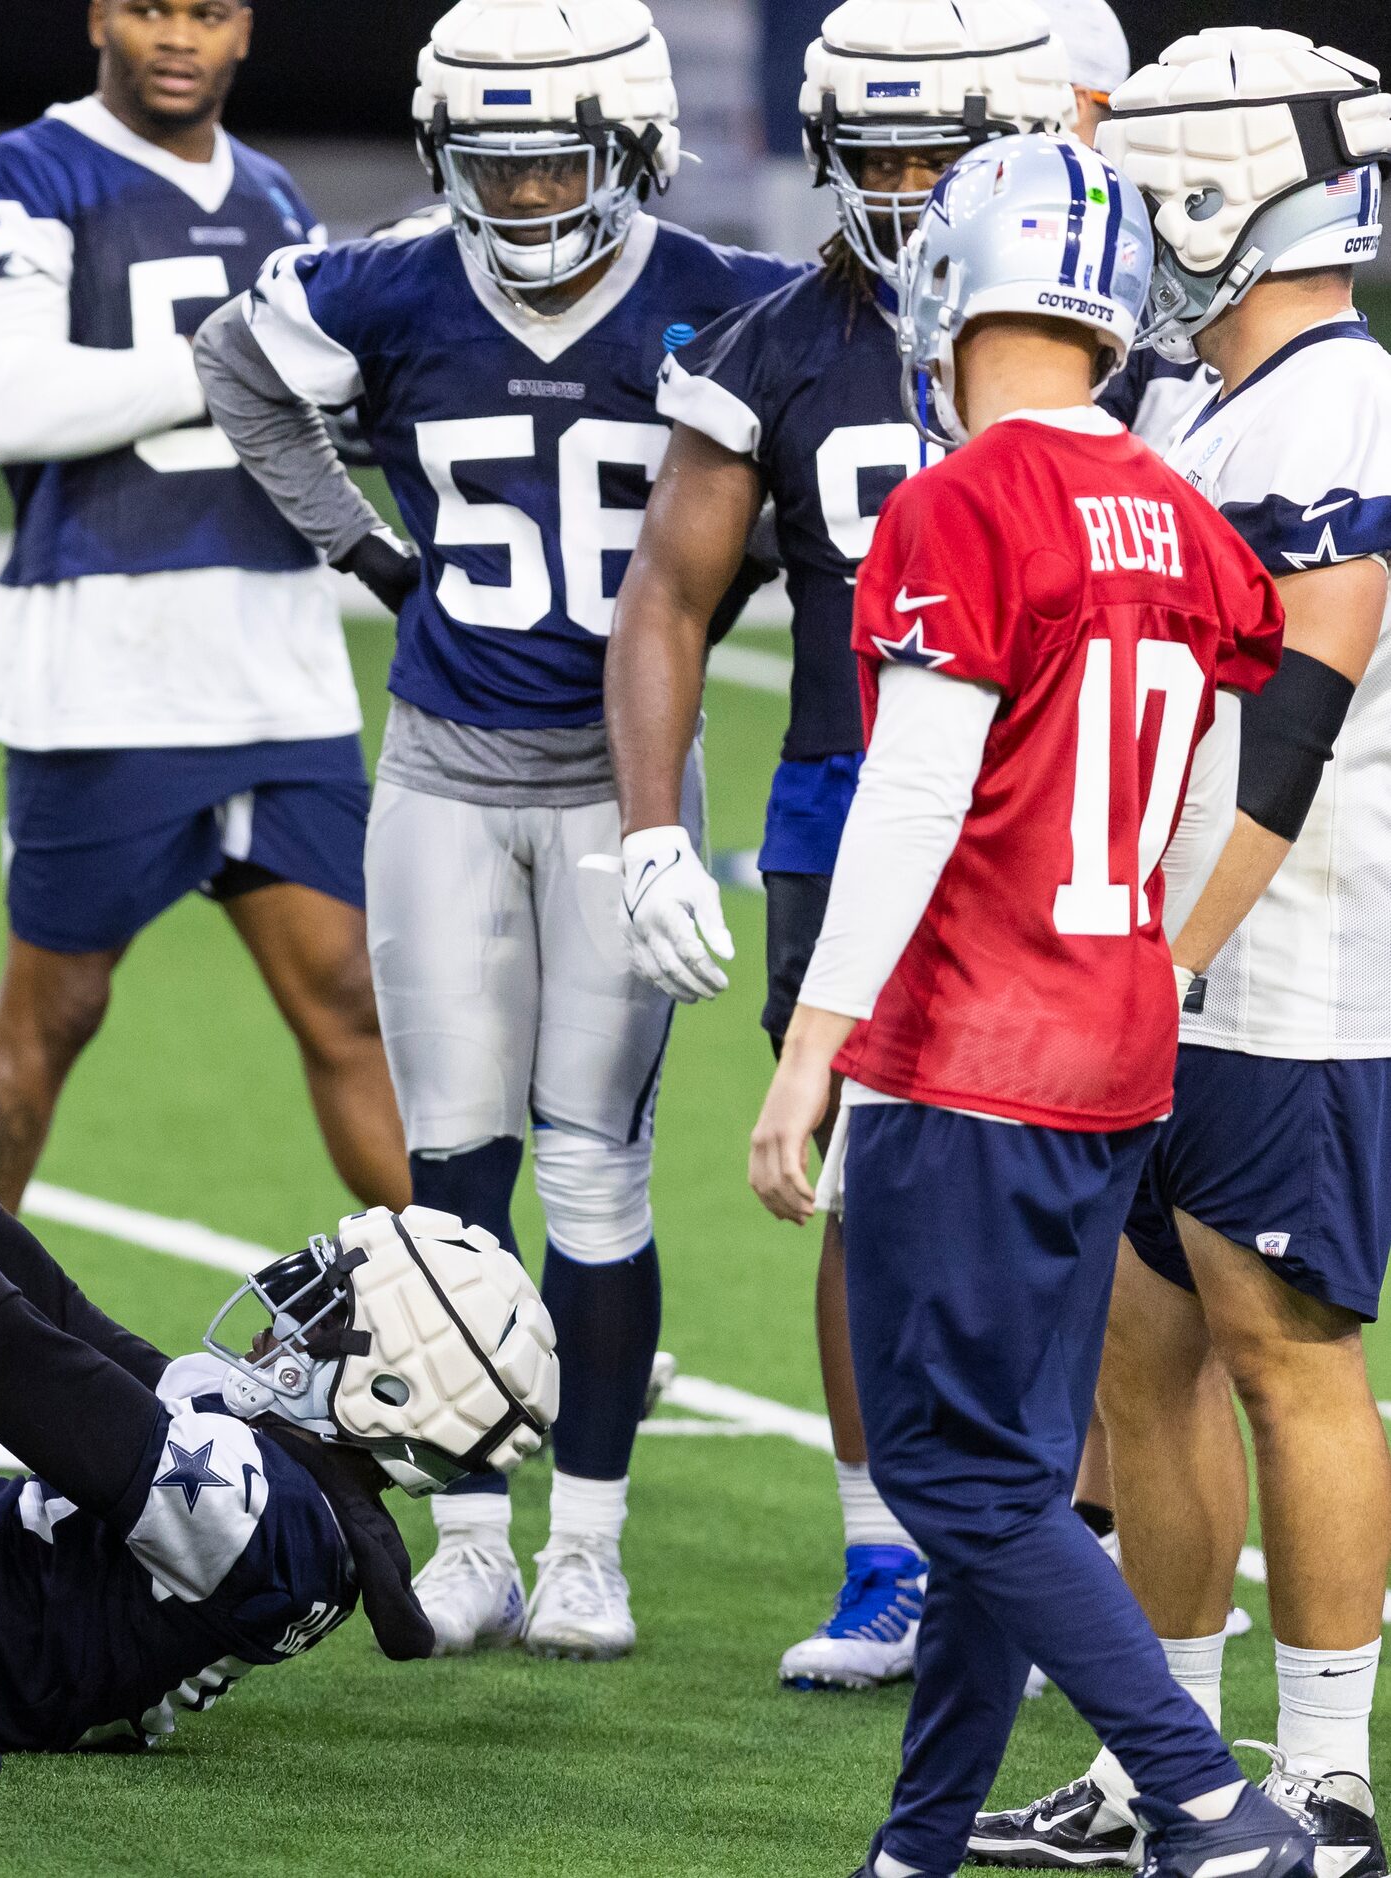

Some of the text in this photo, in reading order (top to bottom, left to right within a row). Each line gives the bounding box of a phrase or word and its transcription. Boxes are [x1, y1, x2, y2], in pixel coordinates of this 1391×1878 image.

[1038, 292, 1114, 322] COWBOYS
[414, 415, 672, 637] 56
[1075, 496, 1184, 578] RUSH
